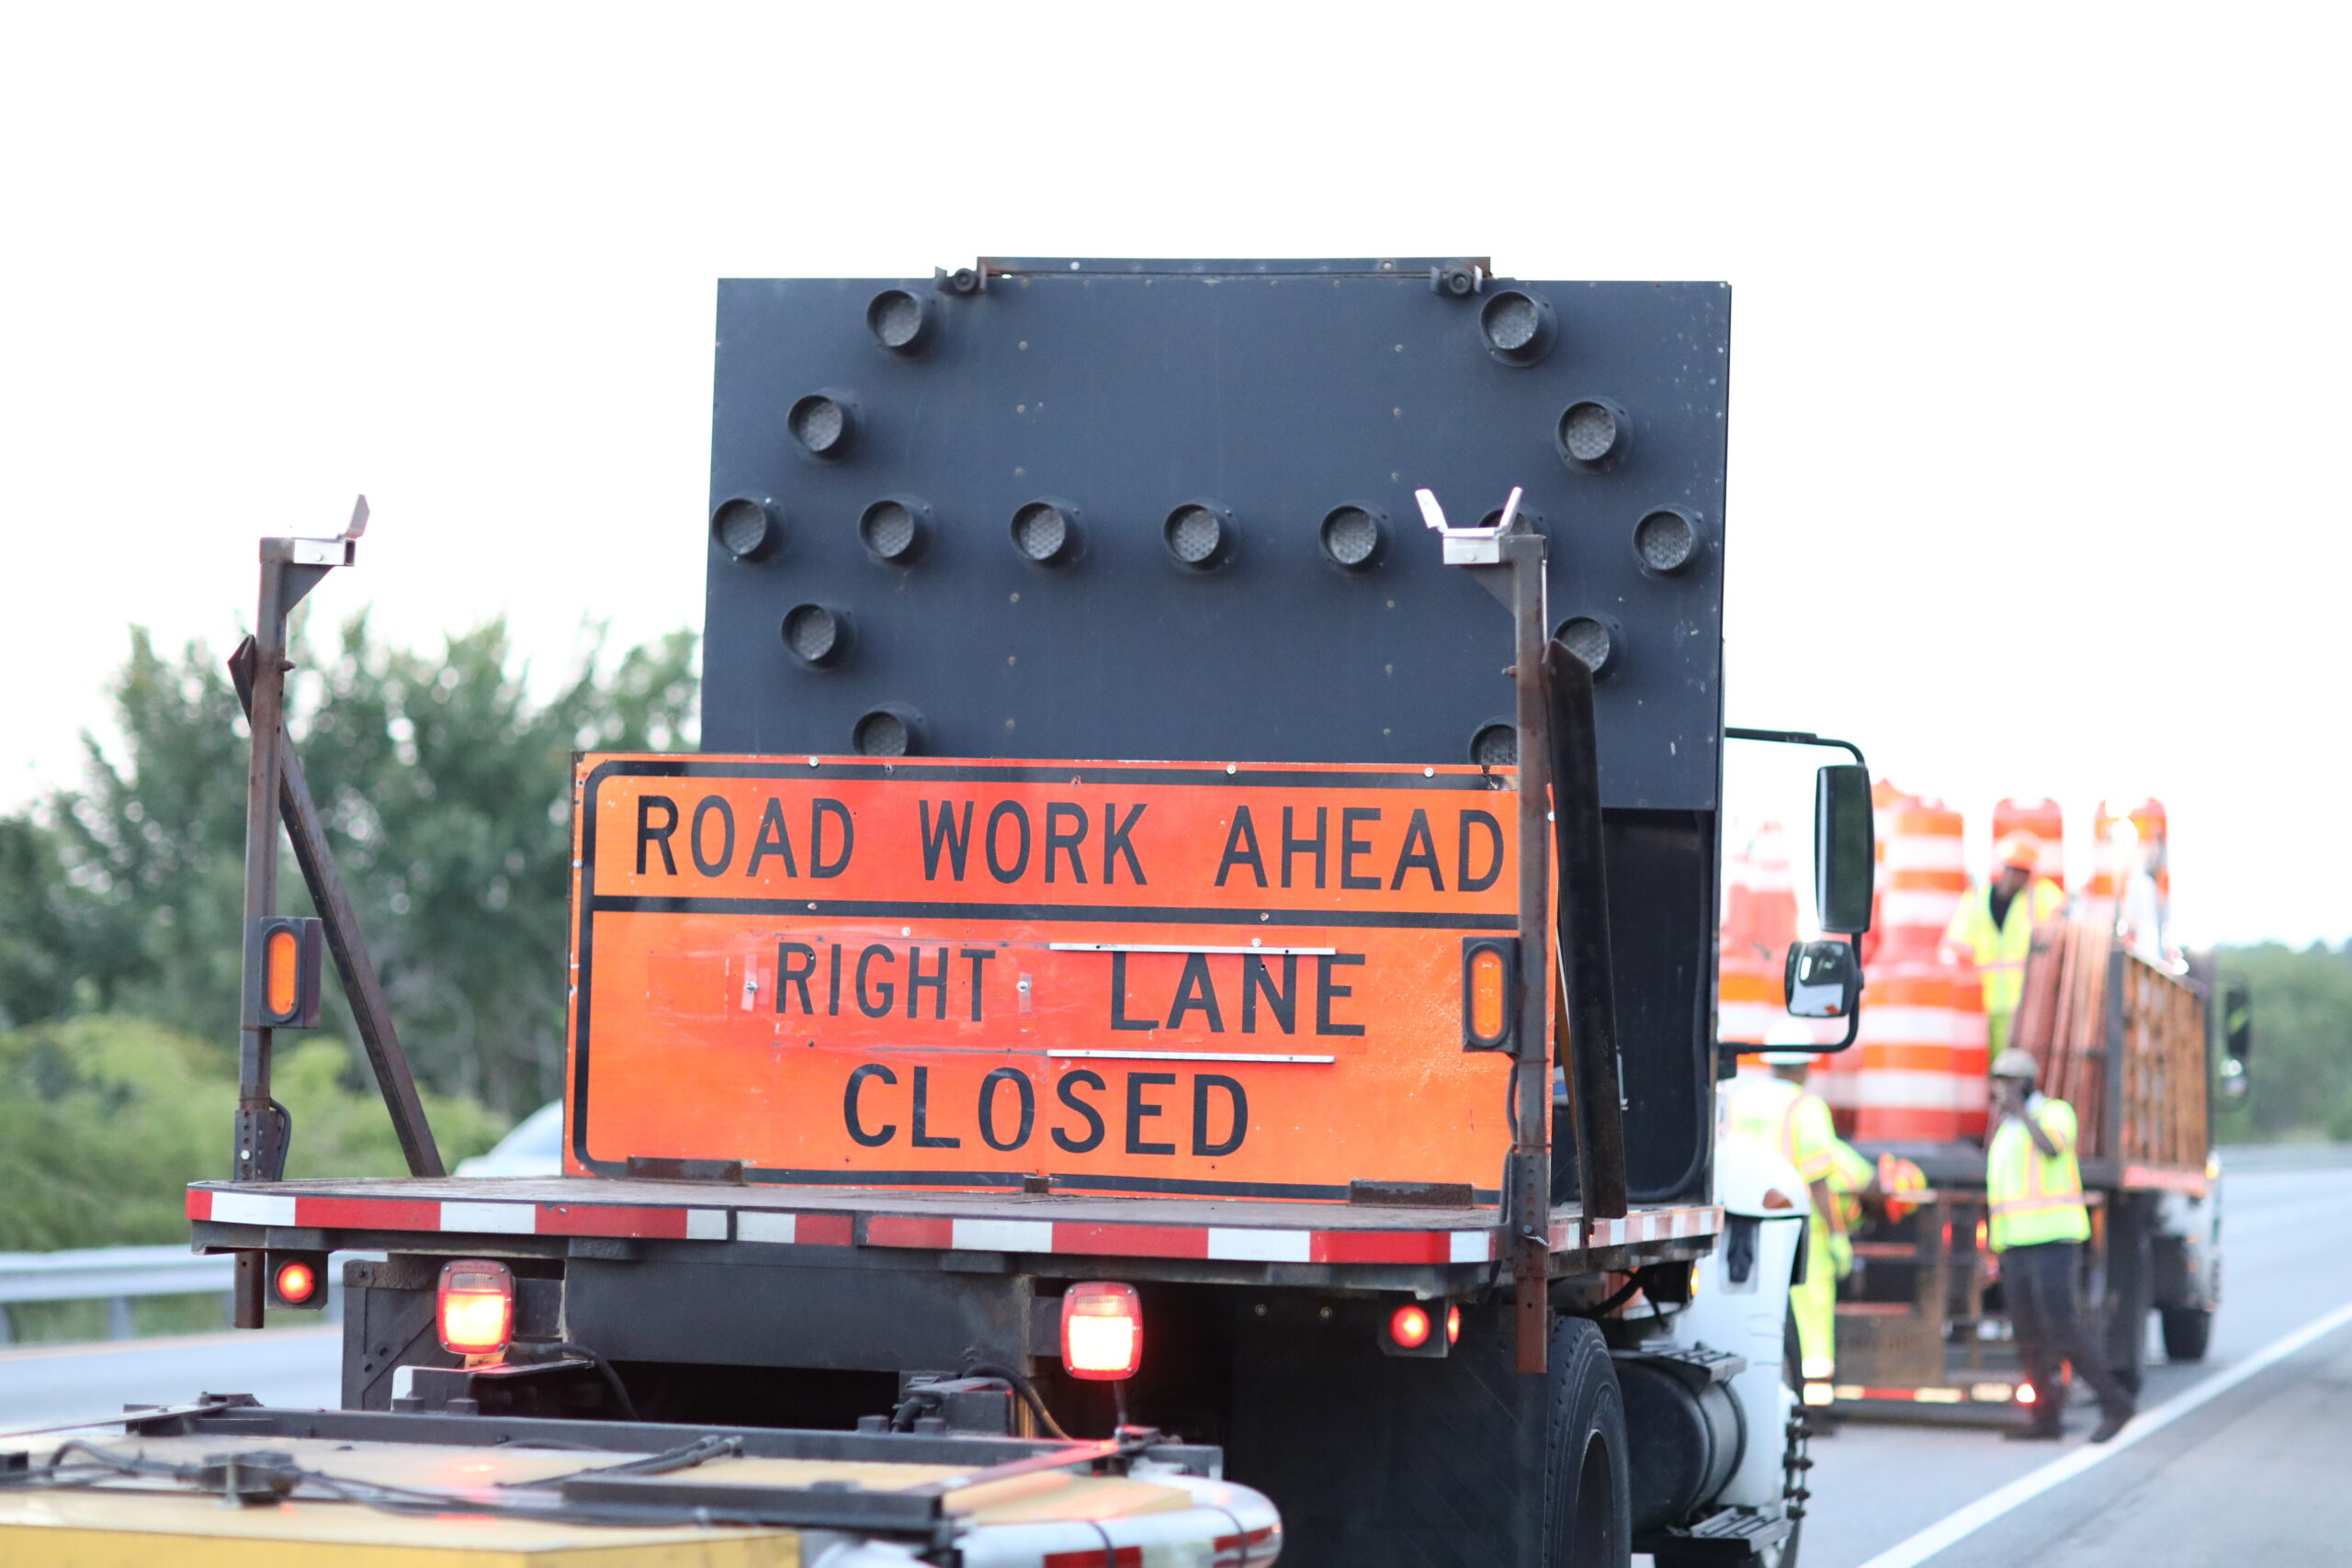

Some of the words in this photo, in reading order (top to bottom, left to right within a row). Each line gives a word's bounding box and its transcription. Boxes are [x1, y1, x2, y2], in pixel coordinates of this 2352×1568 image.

[637, 795, 854, 878] ROAD
[920, 800, 1148, 885] WORK
[1216, 805, 1504, 891] AHEAD
[776, 942, 996, 1021] RIGHT
[1110, 952, 1366, 1036] LANE
[843, 1063, 1249, 1156] CLOSED
